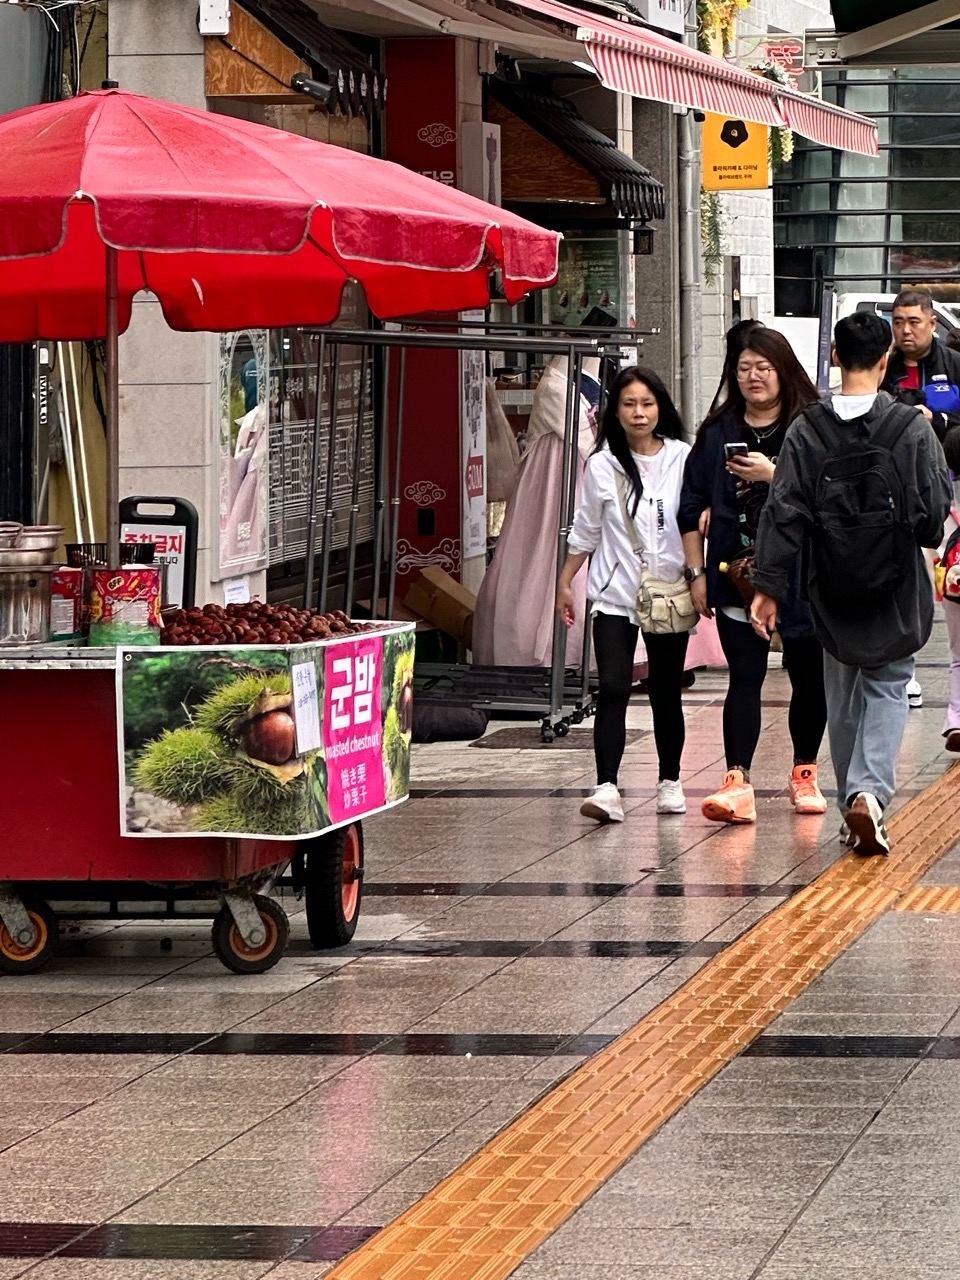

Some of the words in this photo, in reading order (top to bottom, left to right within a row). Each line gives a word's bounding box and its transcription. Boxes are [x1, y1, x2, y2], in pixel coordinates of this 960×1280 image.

[330, 653, 376, 731] 군밤
[325, 736, 350, 759] roasted
[350, 731, 380, 754] chestnut
